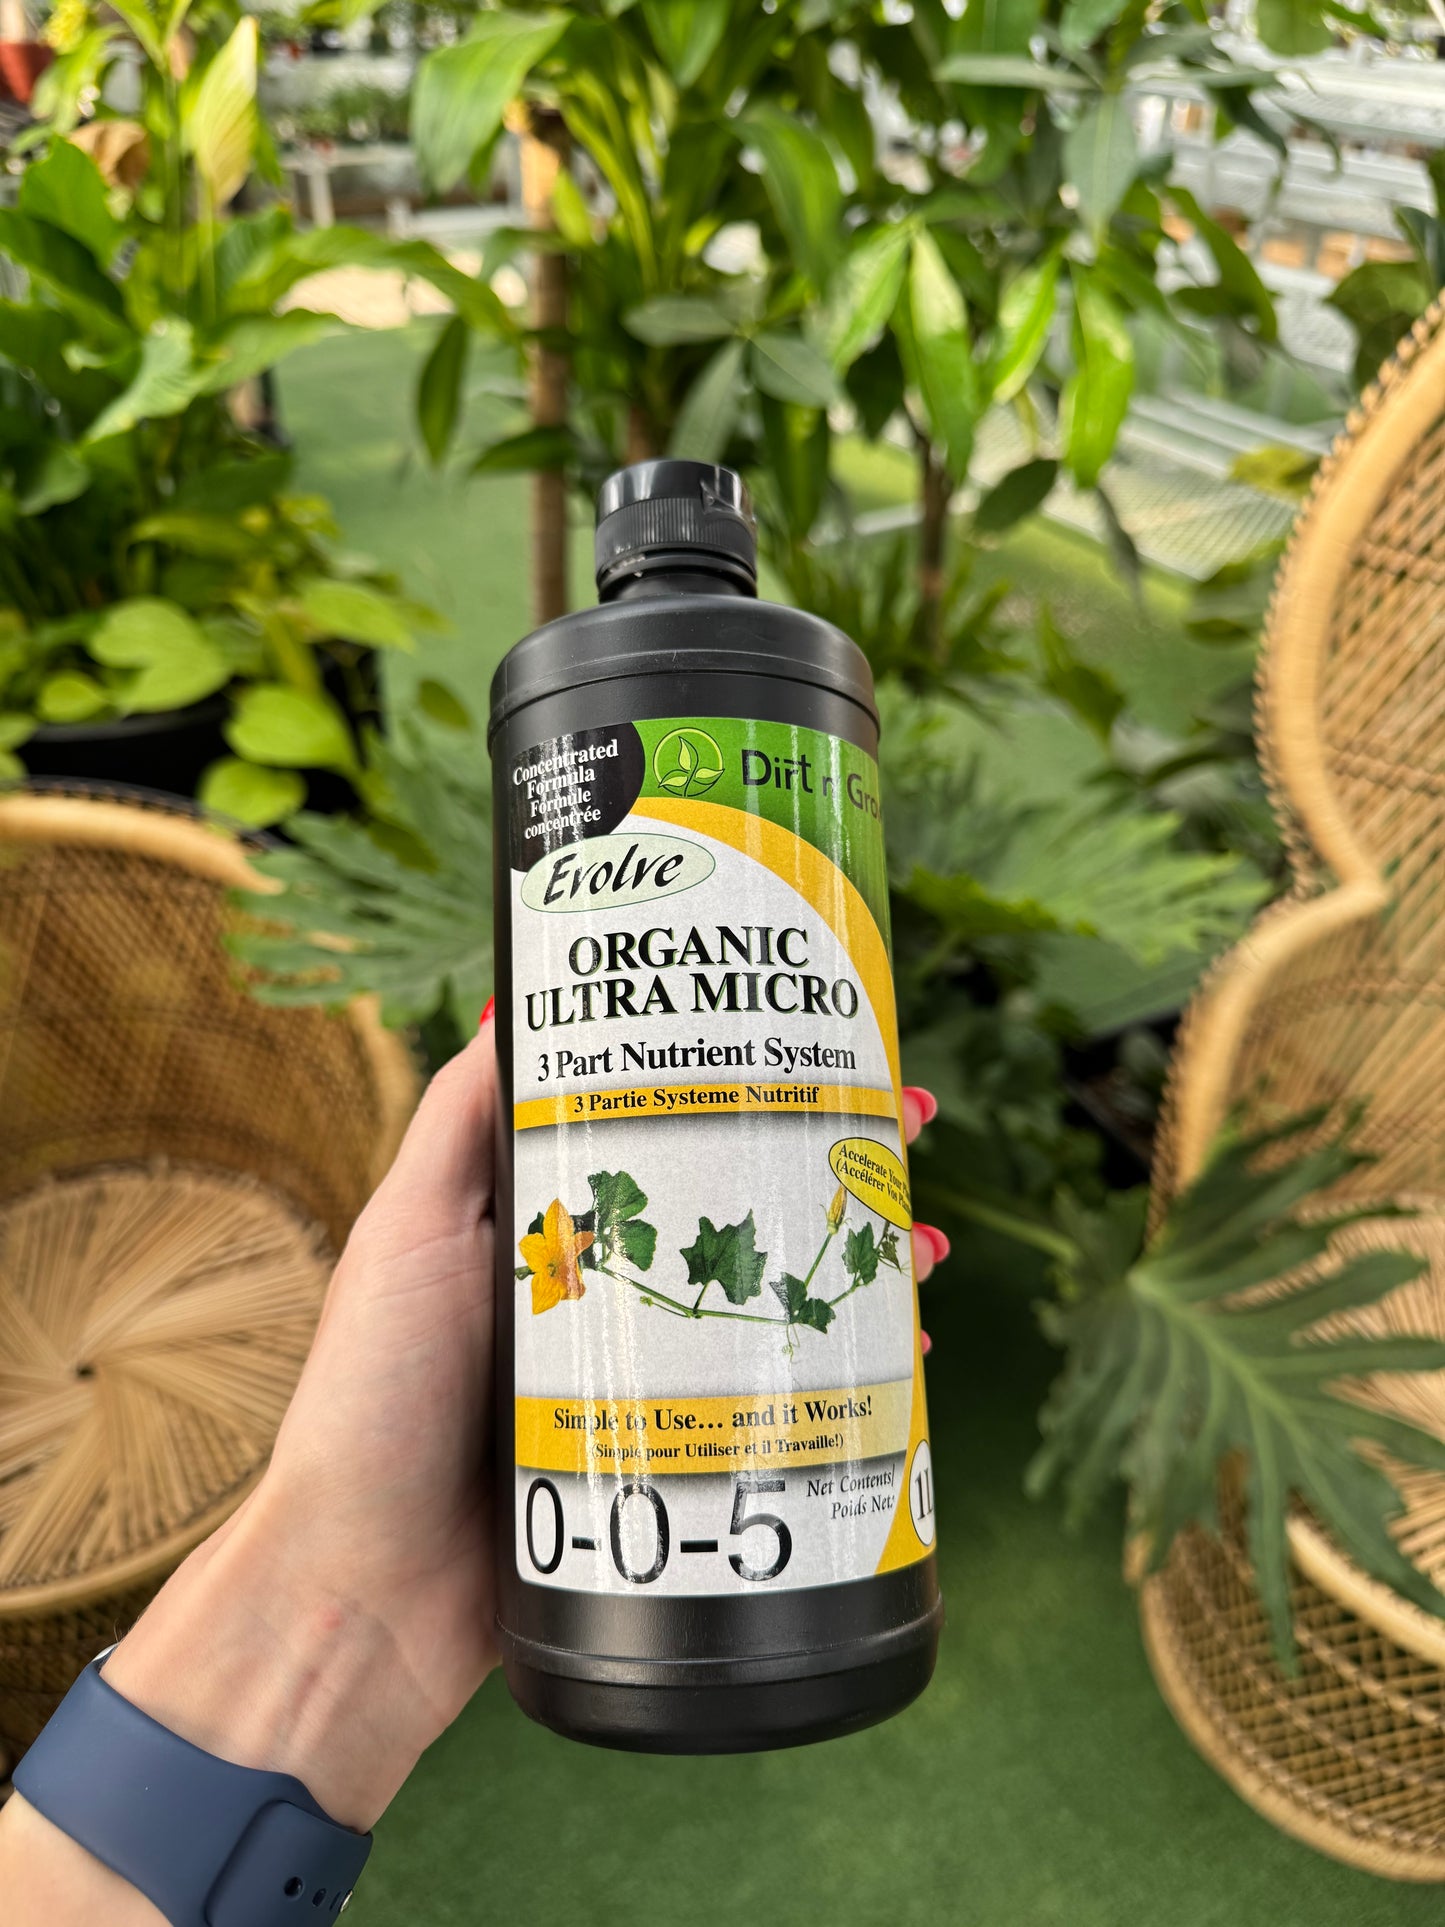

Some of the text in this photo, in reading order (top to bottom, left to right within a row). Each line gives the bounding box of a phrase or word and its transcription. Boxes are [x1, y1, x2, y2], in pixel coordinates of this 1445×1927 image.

[513, 738, 619, 785] Concentrated
[527, 765, 596, 799] Formula
[742, 749, 813, 793] Dirt
[847, 773, 882, 823] Gro
[531, 787, 592, 817] Formule
[525, 805, 601, 839] concentrée
[543, 843, 684, 905] Evolve
[568, 925, 810, 977] ORGANIC
[525, 972, 859, 1031] ULTRA MICRO
[537, 1037, 856, 1081] 3 Part Nutrient System
[574, 1086, 820, 1113] 3 Partie Systeme Nutritif
[836, 1158, 885, 1192] (Accélérer
[839, 1144, 887, 1178] Accelerate
[554, 1395, 873, 1435] Simple to Use... and it Works!
[592, 1433, 844, 1462] (Simple pour Utiliser et il Travaille!)
[806, 1479, 834, 1498] Net
[831, 1494, 894, 1519] Poids Net:
[526, 1478, 793, 1584] 0-0-5
